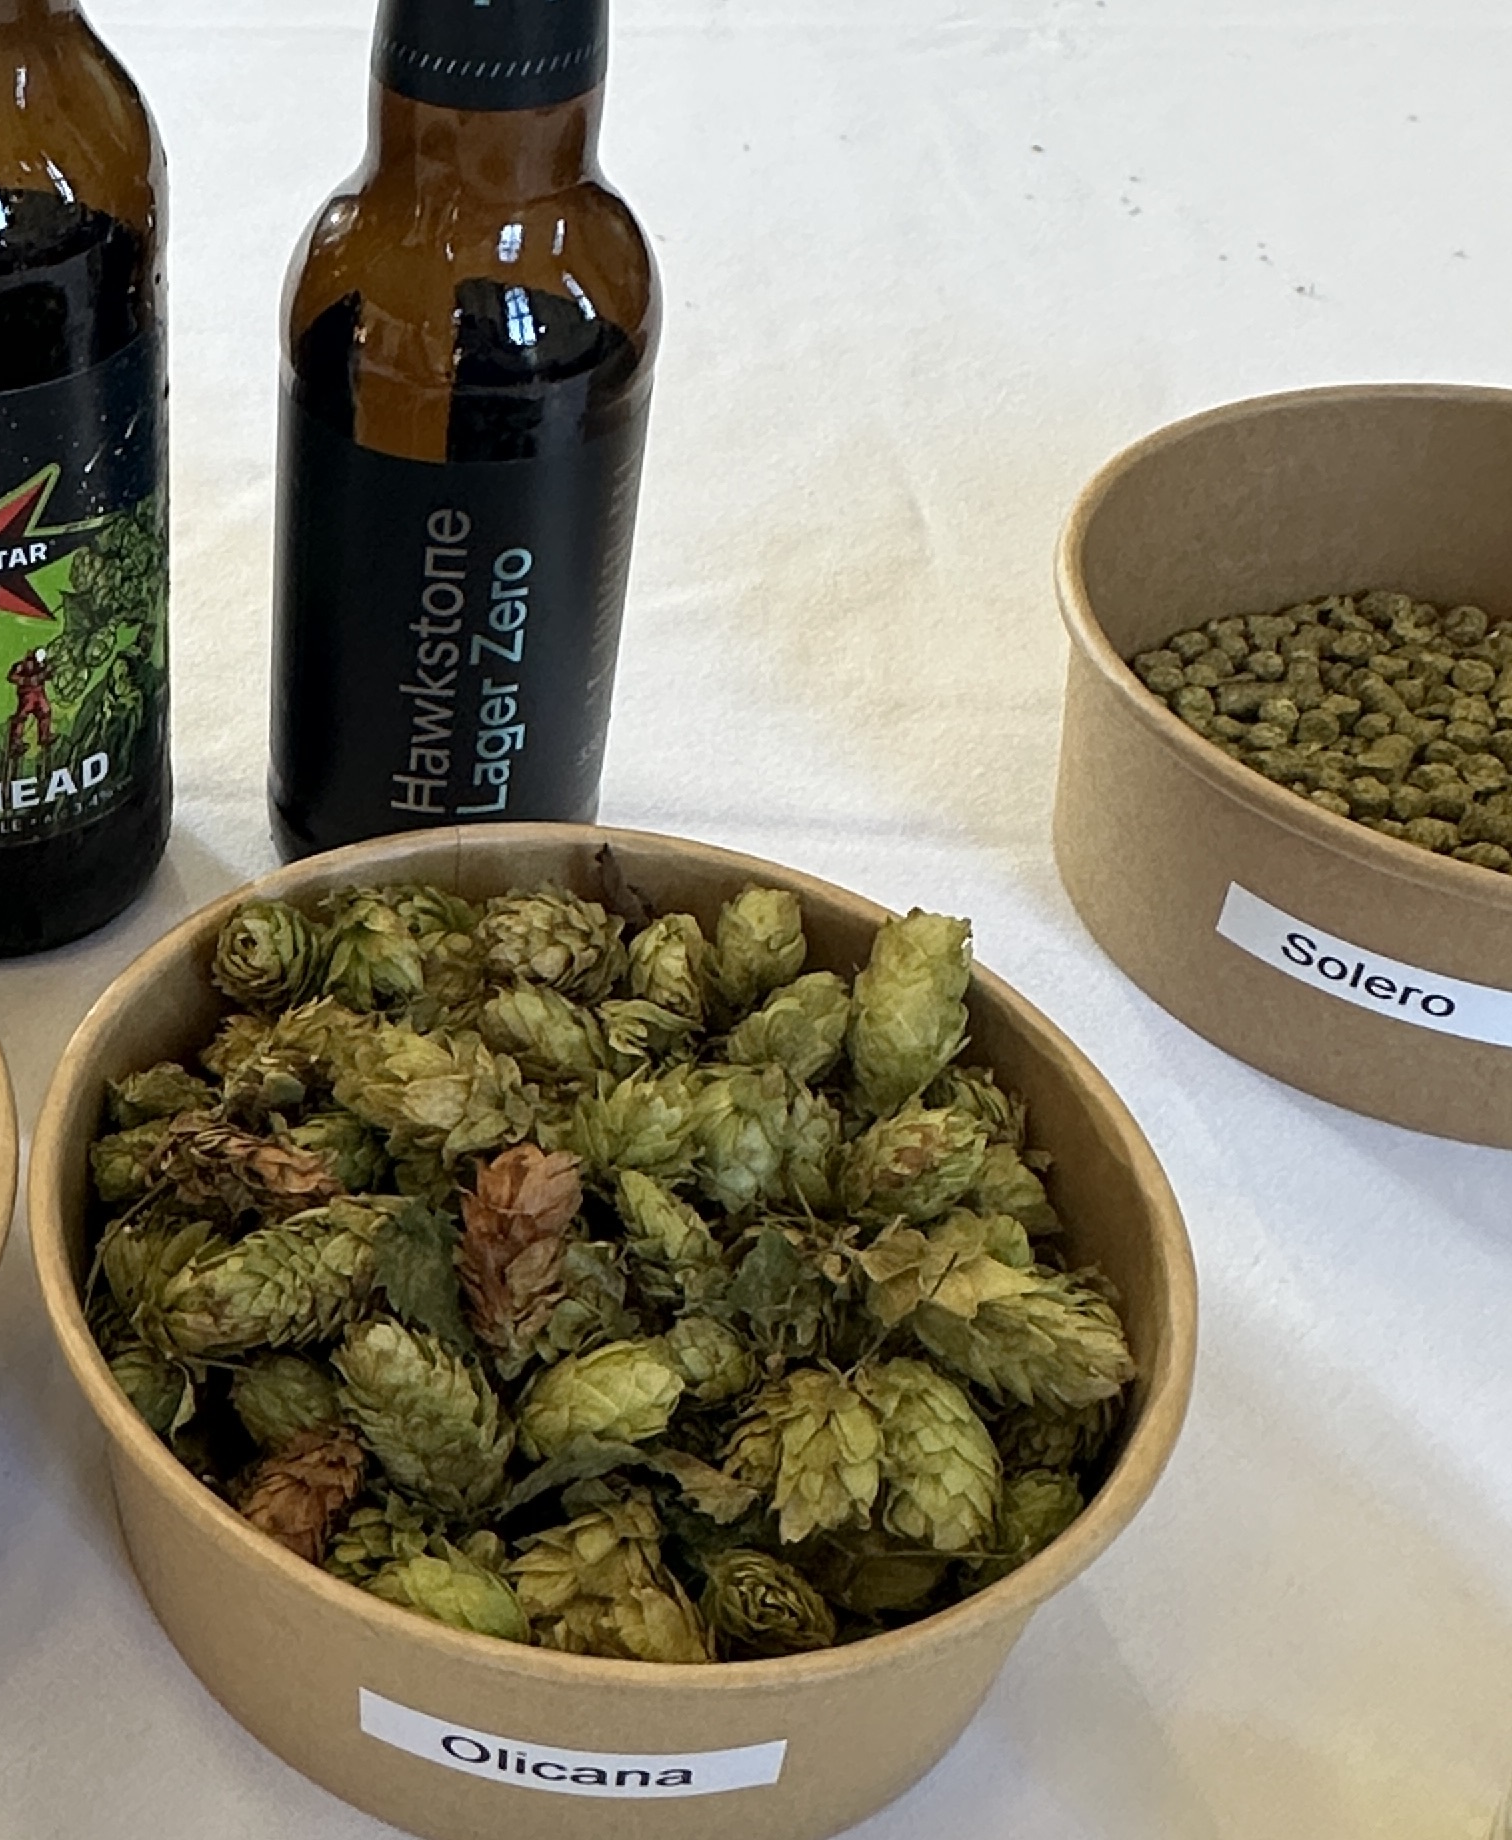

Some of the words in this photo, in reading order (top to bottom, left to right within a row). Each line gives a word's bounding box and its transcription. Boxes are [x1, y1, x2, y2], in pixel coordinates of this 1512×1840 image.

[391, 508, 471, 815] Hawkstone
[469, 547, 534, 666] Zero
[456, 678, 526, 814] Lager
[1280, 932, 1456, 1017] Solero
[441, 1734, 693, 1787] Olicana
